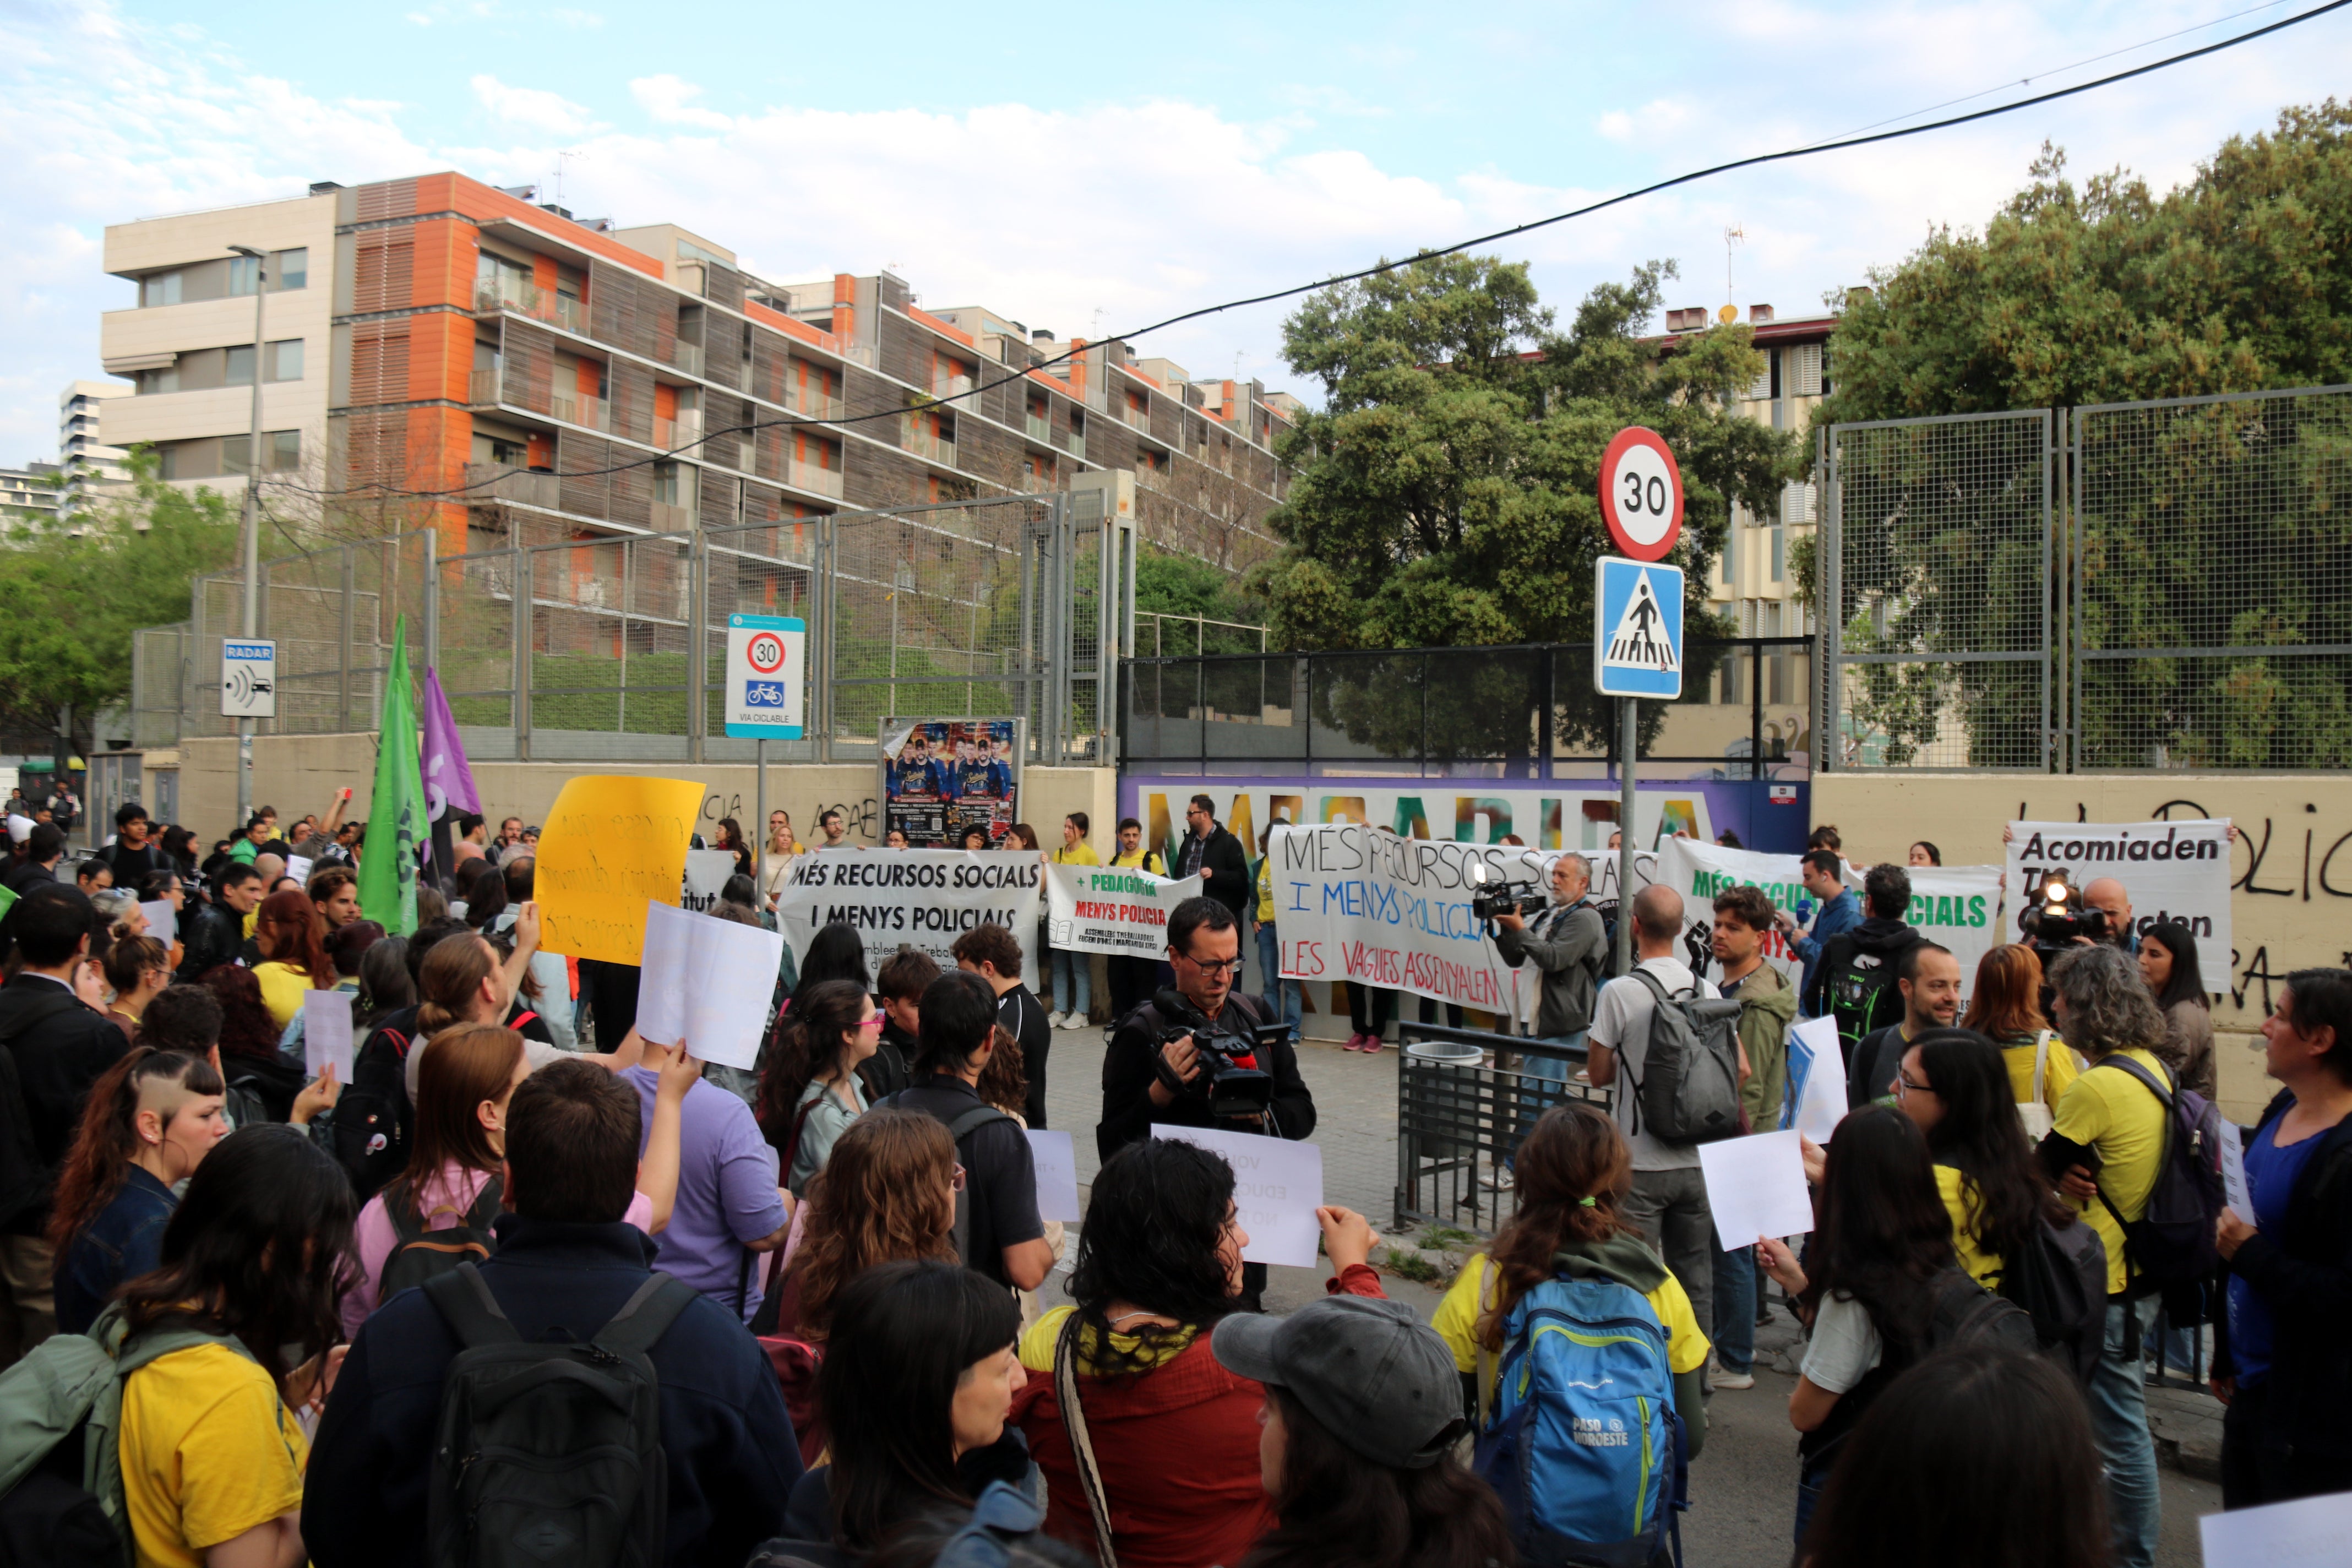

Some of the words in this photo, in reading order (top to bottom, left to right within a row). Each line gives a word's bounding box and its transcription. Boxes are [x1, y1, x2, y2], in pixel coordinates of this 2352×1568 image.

[1624, 471, 1667, 516] 30
[227, 647, 271, 658] RADAR
[756, 643, 776, 663] 30
[739, 714, 752, 722] VIA
[754, 714, 790, 723] CICLABLE
[2019, 827, 2219, 862] Acomiaden
[1285, 825, 1364, 873] MÉS
[1370, 832, 1507, 891] RECURSOS
[788, 859, 830, 887] MÉS
[834, 864, 946, 889] RECURSOS
[953, 864, 1039, 889] SOCIALS
[1091, 874, 1157, 897] PEDAGOGIA
[1075, 900, 1116, 921] MENYS
[1119, 904, 1167, 926] POLICIA
[1289, 881, 1312, 911] I
[1323, 881, 1401, 925] MENYS
[811, 905, 819, 928] I
[826, 905, 905, 931] MENYS
[913, 907, 1017, 933] POLICIALS
[1078, 935, 1096, 944] EUGENI
[1097, 937, 1112, 945] D'ORS
[1085, 928, 1115, 938] ASSEMBLEES
[1117, 931, 1155, 942] TREBALLADORES
[1282, 940, 1325, 977] LES
[1342, 940, 1400, 984] VAGUES
[1403, 951, 1499, 1008] ASSENYALEN
[1848, 974, 1865, 983] TVU
[1572, 1417, 1603, 1433] PASO
[1573, 1431, 1629, 1447] NOROESTE
